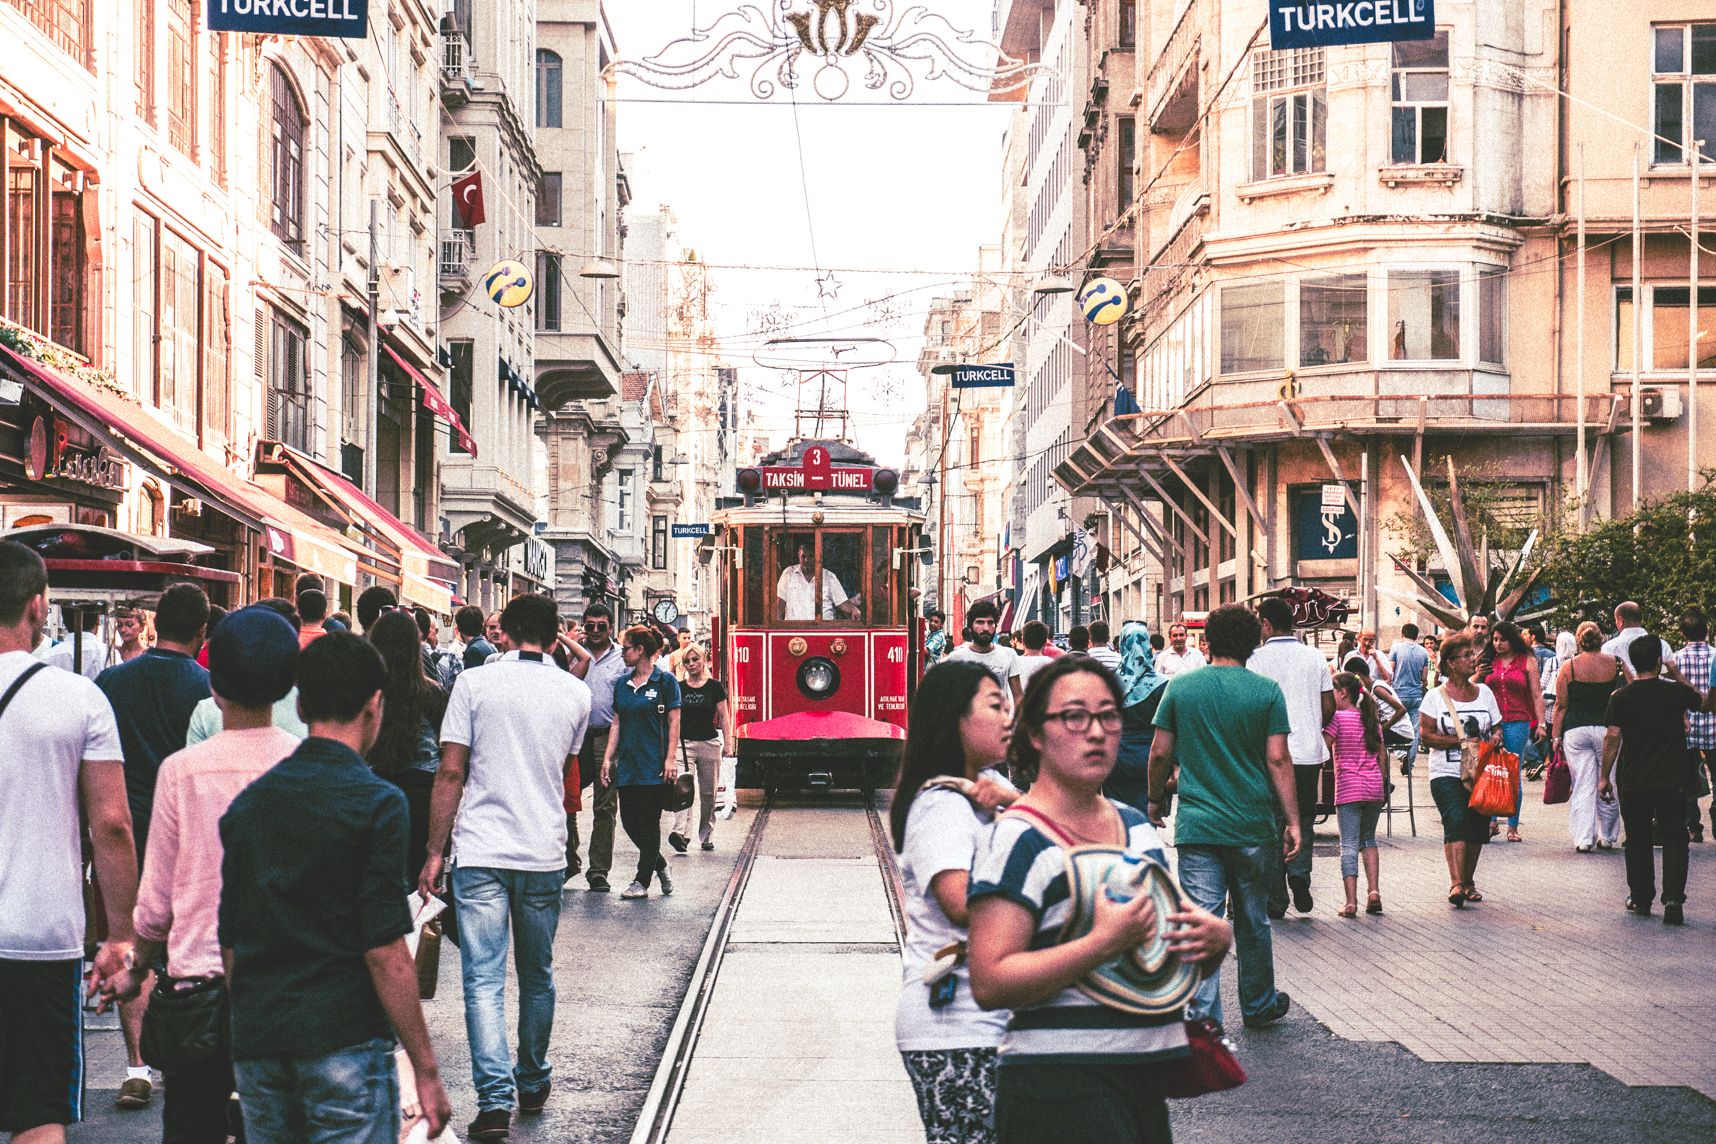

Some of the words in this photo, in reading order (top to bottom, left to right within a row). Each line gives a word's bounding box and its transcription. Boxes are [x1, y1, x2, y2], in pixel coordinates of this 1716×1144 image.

[220, 0, 359, 20] TURKCELL
[1278, 0, 1425, 32] TURKCELL
[954, 369, 1011, 382] TURKCELL
[812, 449, 821, 465] 3
[830, 470, 868, 488] TÜNEL
[887, 646, 903, 663] 410
